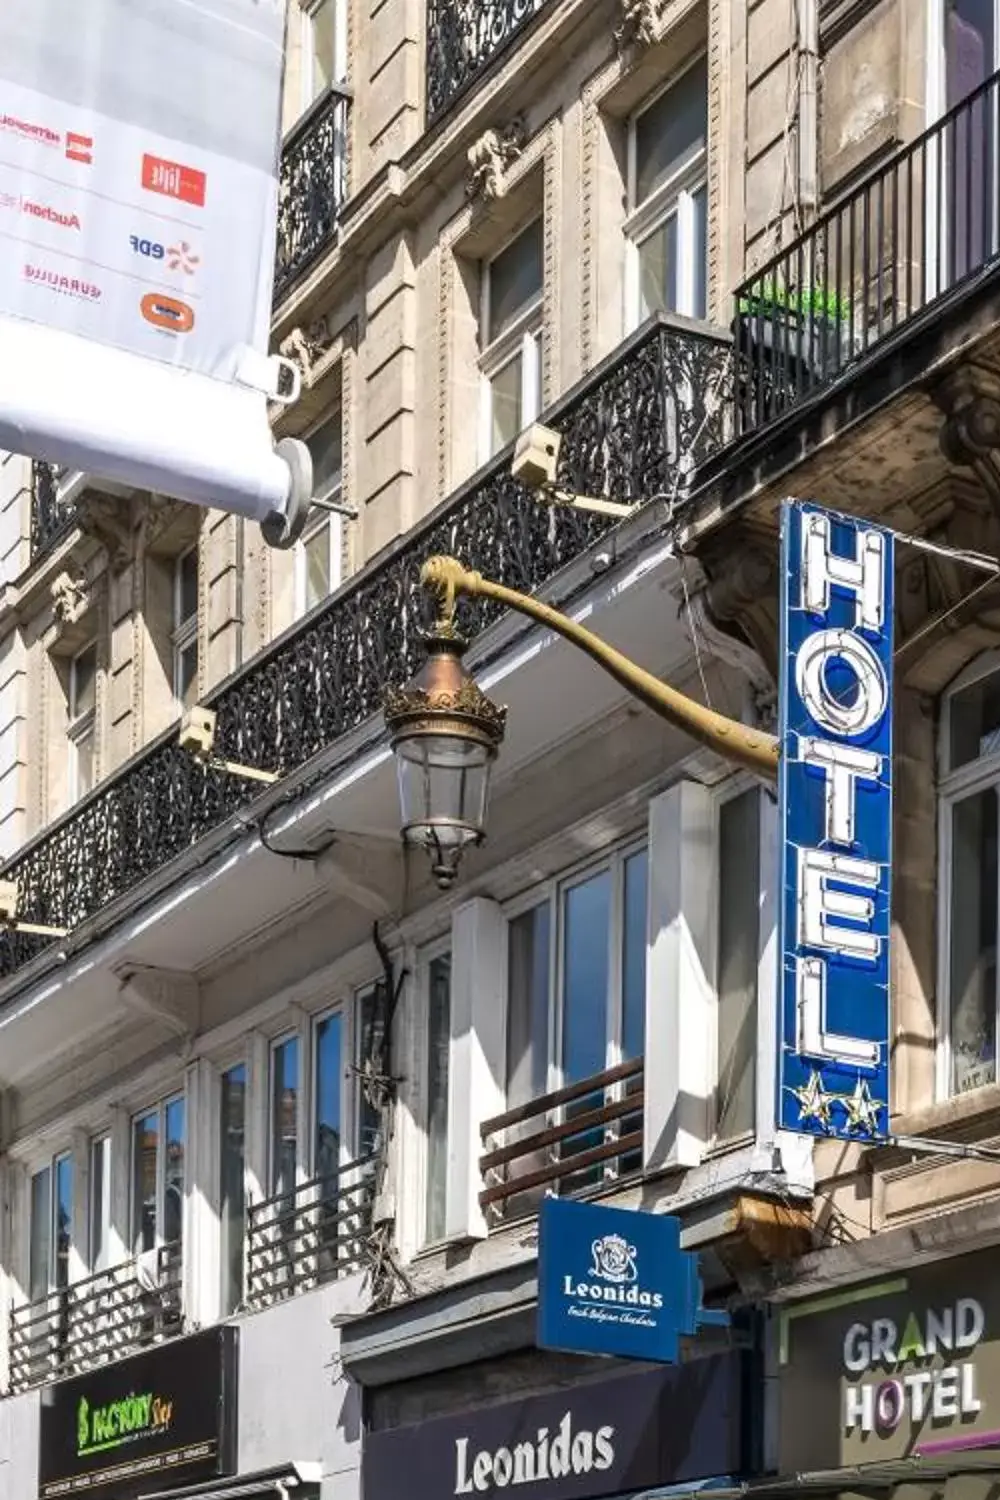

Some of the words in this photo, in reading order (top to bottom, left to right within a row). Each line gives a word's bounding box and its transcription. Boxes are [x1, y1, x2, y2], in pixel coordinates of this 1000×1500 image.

[795, 513, 887, 1065] HOTEL
[563, 1275, 664, 1308] Leonidas
[843, 1297, 985, 1372] GRAND
[844, 1363, 981, 1431] HOTEL
[453, 1410, 615, 1495] Leonidas
